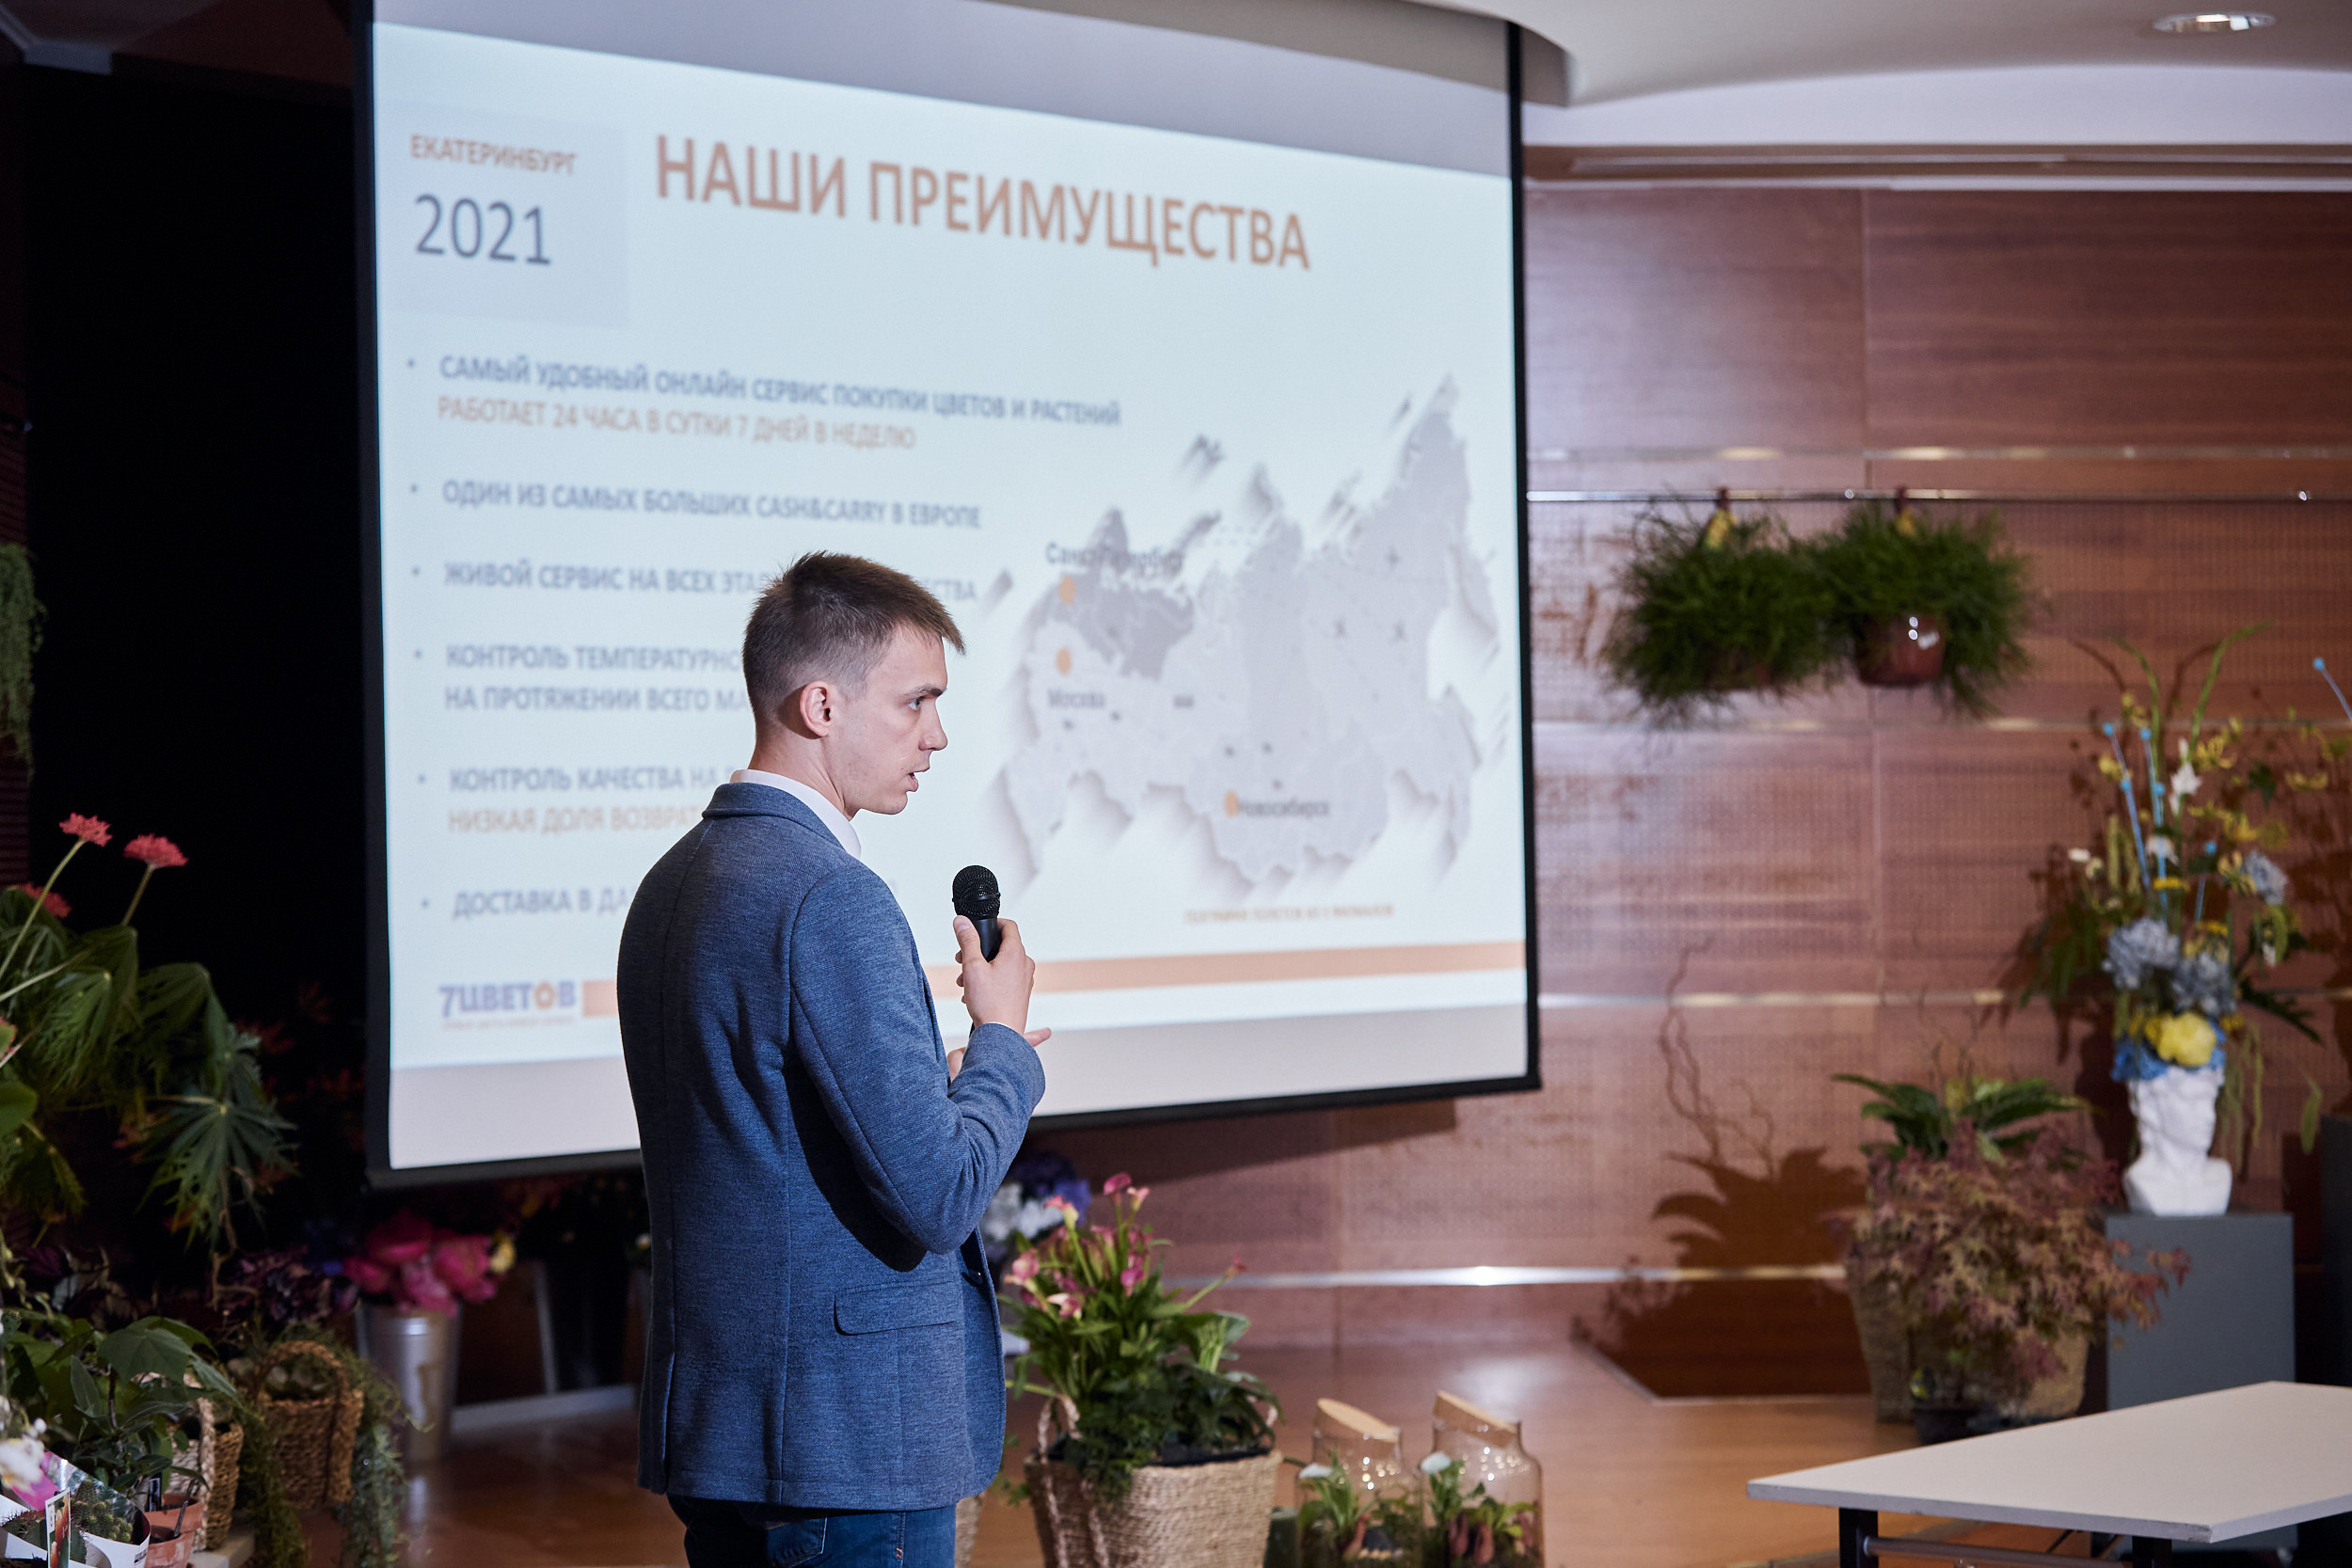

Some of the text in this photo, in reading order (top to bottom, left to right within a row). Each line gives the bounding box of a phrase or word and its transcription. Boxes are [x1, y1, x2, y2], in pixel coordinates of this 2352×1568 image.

[410, 134, 578, 175] ЕКАТЕРИНБУРГ
[657, 135, 1311, 271] НАШИ ПРЕИМУЩЕСТВА
[415, 194, 551, 264] 2021
[439, 354, 1122, 427] САМЫЙ УДОБНЫЙ ОНЛАЙН СЕРВИС ПОКУПКИ ЦВЕТОВ И РАСТЕНИЙ
[437, 395, 915, 451] РАБОТАЕТ 24 ЧАСА В СУТКИ 7 ДНЕЙ В НЕДЕЛЮ
[442, 479, 981, 530] ОДИН ИЗ САМЫХ БОЛЬШИХ CASH&CARRY В ЕВРОПЕ
[444, 559, 534, 588] ЖИВОЙ
[537, 564, 624, 591] СЕРВИС
[628, 568, 659, 593] НА
[666, 568, 716, 594] ВСЕХ
[446, 644, 743, 673] КОНТРОЛЬ ТЕМПЕРАТУРНО
[444, 687, 478, 711] НА
[483, 687, 642, 711] ПРОТЯЖЕНИИ
[647, 688, 709, 713] ВСЕГО
[449, 767, 571, 792] КОНТРОЛЬ
[577, 766, 685, 791] КАЧЕСТВА
[690, 768, 717, 790] НА
[447, 808, 537, 833] НИЗКАЯ
[540, 807, 604, 837] ДОЛЯ
[452, 890, 571, 922] ДОСТАВКА
[577, 889, 593, 911] В
[439, 980, 576, 1019] 7ЦВЕТОВ
